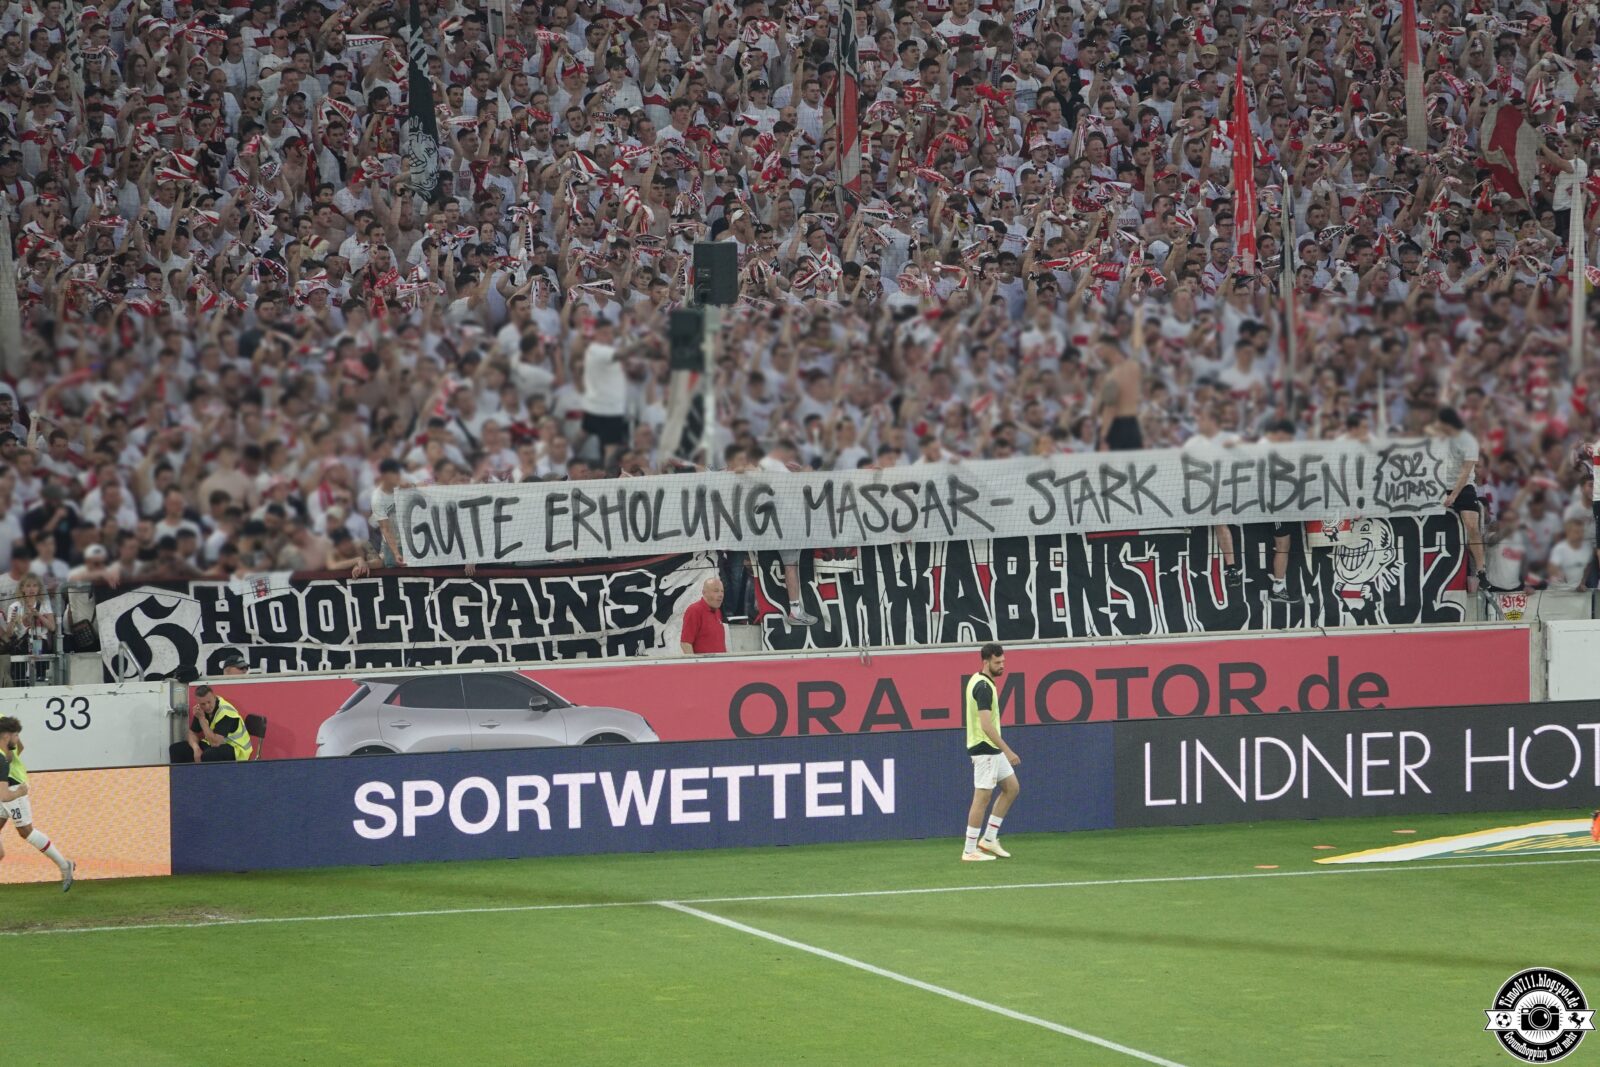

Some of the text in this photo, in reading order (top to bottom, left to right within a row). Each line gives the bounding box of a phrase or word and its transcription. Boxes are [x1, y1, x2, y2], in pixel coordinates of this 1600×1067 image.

[404, 494, 524, 560] GUTE
[544, 483, 784, 552] ERHOLUNG
[1026, 462, 1174, 526] STARK
[1180, 452, 1366, 516] BLEIBEN!
[1385, 480, 1438, 503] ULTRAS
[1381, 510, 1467, 626] 02
[191, 570, 657, 646] HOOLIGANS
[45, 696, 91, 731] 33
[352, 758, 896, 840] SPORTWETTEN
[1144, 731, 1432, 807] LINDNER
[10, 807, 22, 820] 28
